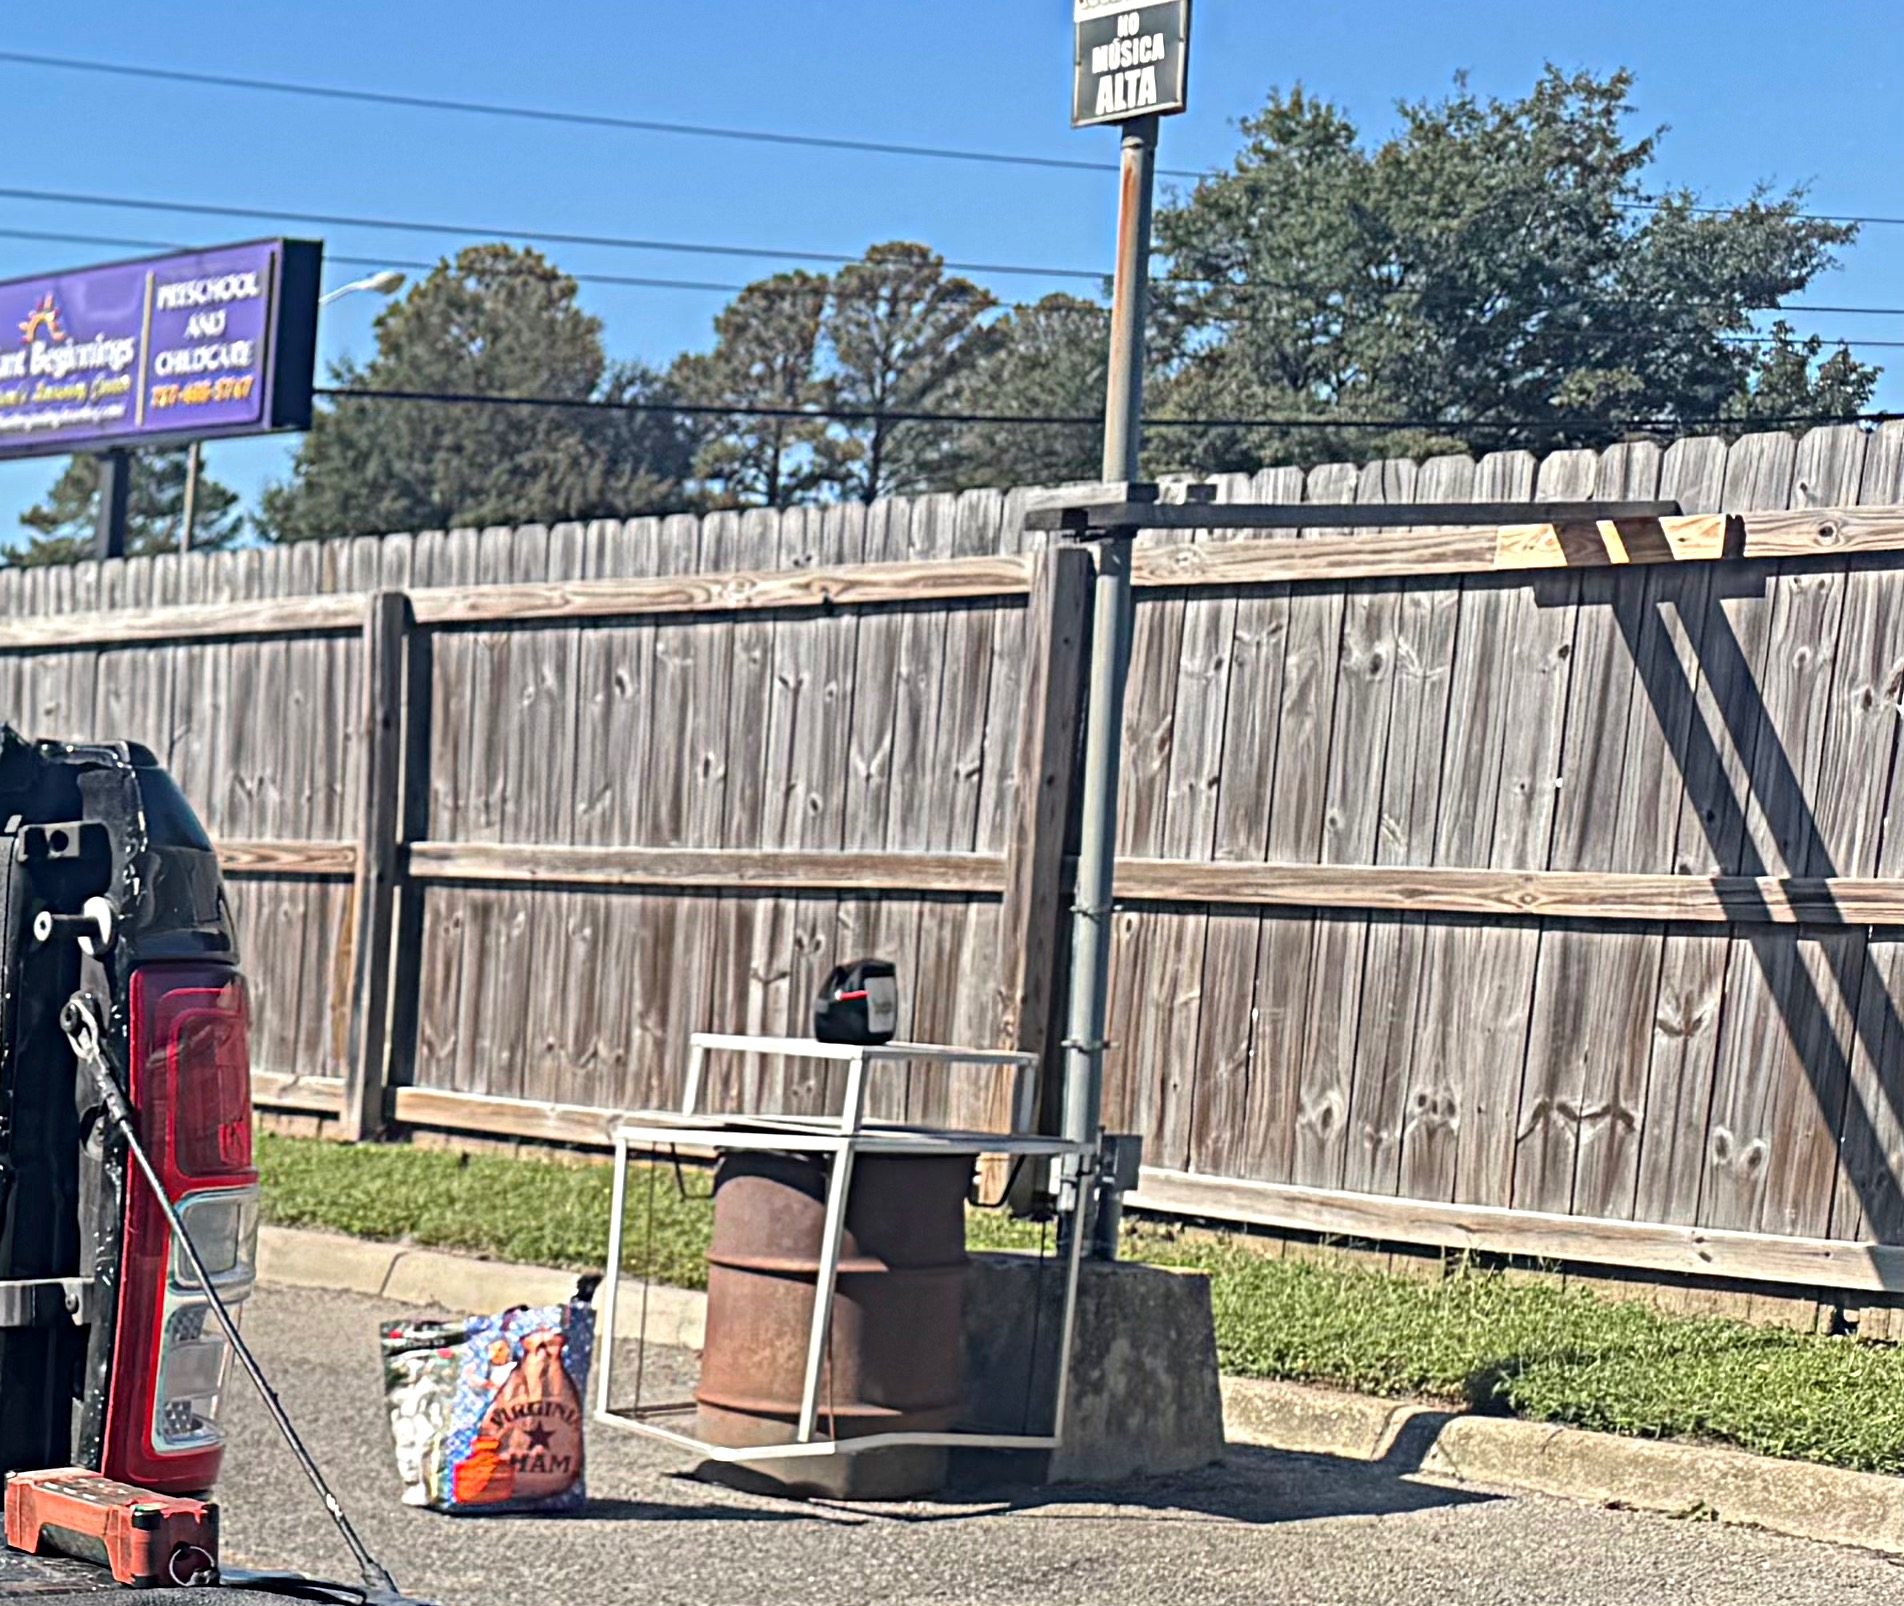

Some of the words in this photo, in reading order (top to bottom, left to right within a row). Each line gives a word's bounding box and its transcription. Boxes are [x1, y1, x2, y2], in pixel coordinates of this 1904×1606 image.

[1117, 12, 1140, 38] NO
[1096, 65, 1157, 115] ALTA
[184, 309, 226, 339] AND
[509, 1453, 571, 1473] HAM
